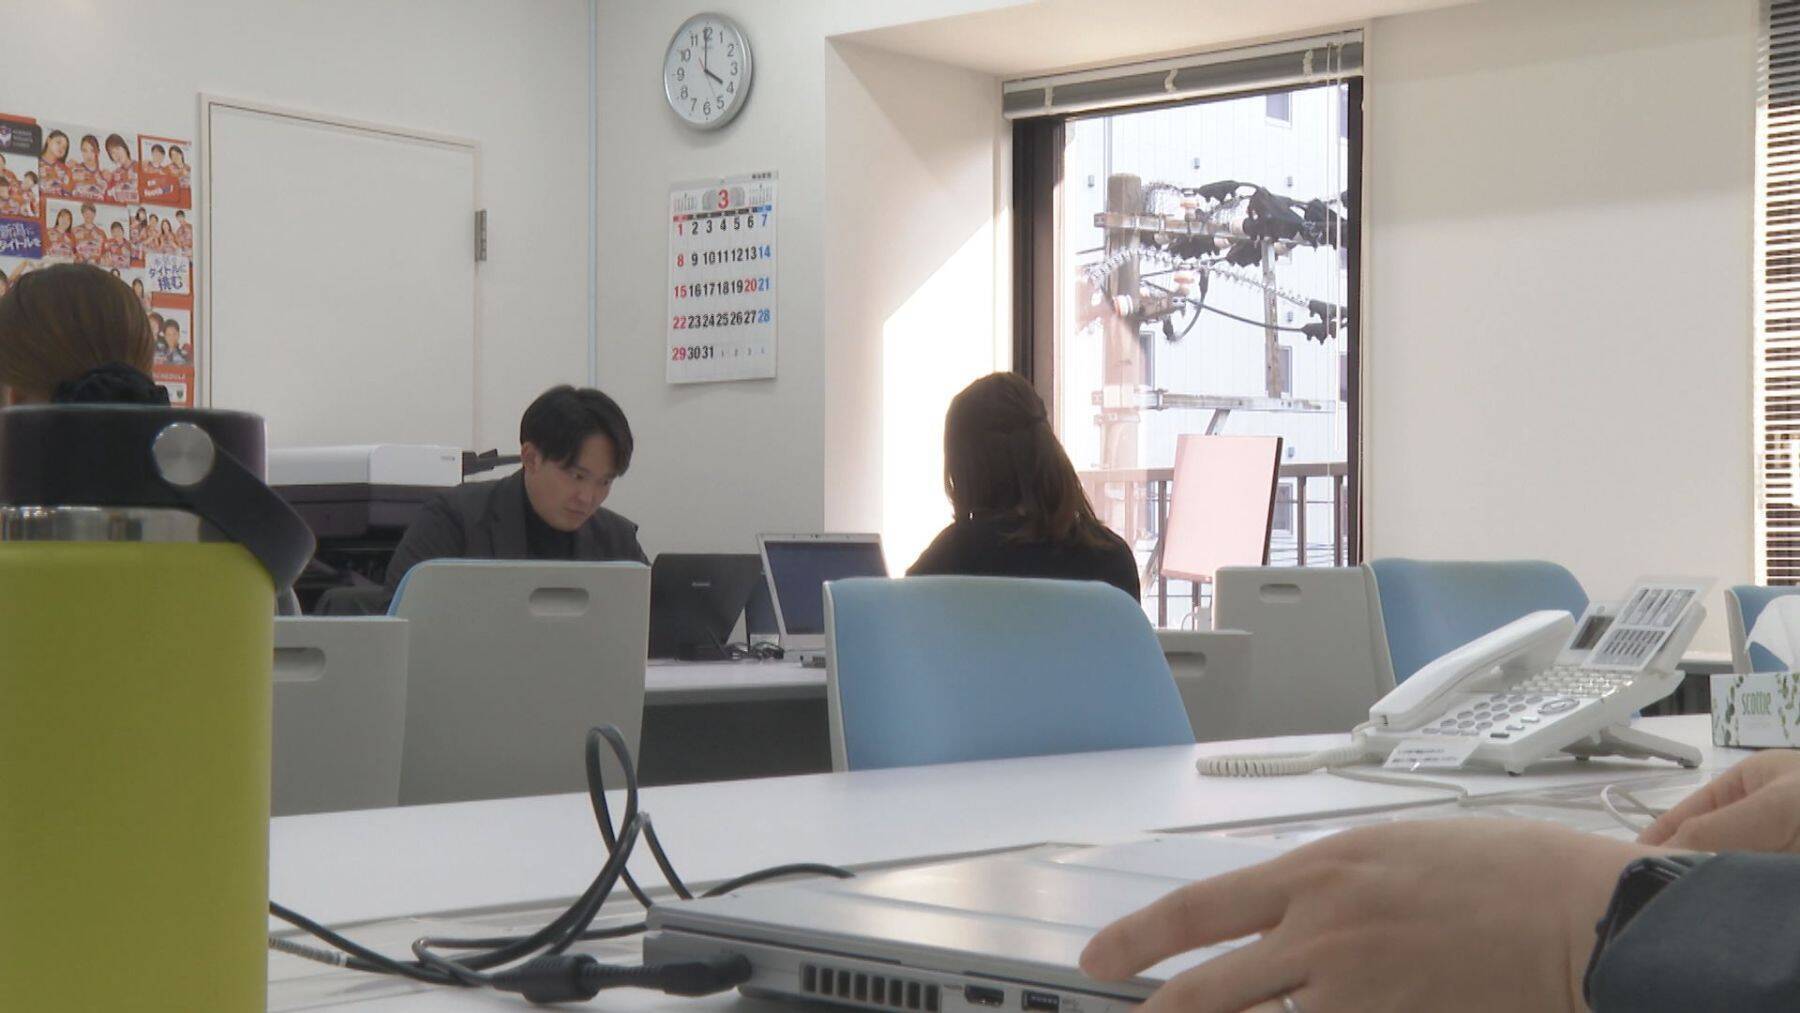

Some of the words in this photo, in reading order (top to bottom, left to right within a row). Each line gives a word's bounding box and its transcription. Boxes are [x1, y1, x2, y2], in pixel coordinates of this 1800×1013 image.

[690, 33, 698, 47] 11
[680, 48, 691, 62] 10
[727, 43, 735, 57] 2
[676, 67, 685, 81] 9
[730, 61, 738, 76] 3
[680, 86, 689, 100] 8
[726, 80, 734, 94] 4
[690, 98, 698, 112] 7
[702, 101, 711, 116] 6
[716, 95, 725, 110] 5
[718, 188, 729, 210] 3
[678, 223, 683, 236] 1
[692, 222, 698, 235] 2
[706, 220, 712, 234] 3
[720, 218, 726, 231] 4
[734, 217, 740, 230] 5
[747, 215, 754, 228] 6
[762, 214, 768, 227] 7
[677, 254, 684, 267] 8
[692, 252, 698, 266] 9
[703, 251, 716, 265] 10
[717, 250, 729, 264] 11
[731, 248, 744, 262] 12
[744, 246, 757, 260] 13
[759, 245, 770, 259] 14
[674, 285, 687, 299] 15
[689, 284, 702, 297] 16
[703, 282, 715, 296] 17
[717, 281, 730, 295] 18
[731, 280, 744, 294] 19
[744, 278, 757, 292] 20
[758, 278, 770, 292] 21
[673, 316, 686, 330] 22
[688, 314, 701, 329] 23
[702, 314, 714, 328] 24
[716, 312, 728, 326] 25
[730, 311, 743, 326] 26
[744, 310, 757, 324] 27
[758, 308, 770, 324] 28
[672, 346, 686, 360] 29
[688, 346, 700, 360] 30
[702, 345, 714, 359] 31
